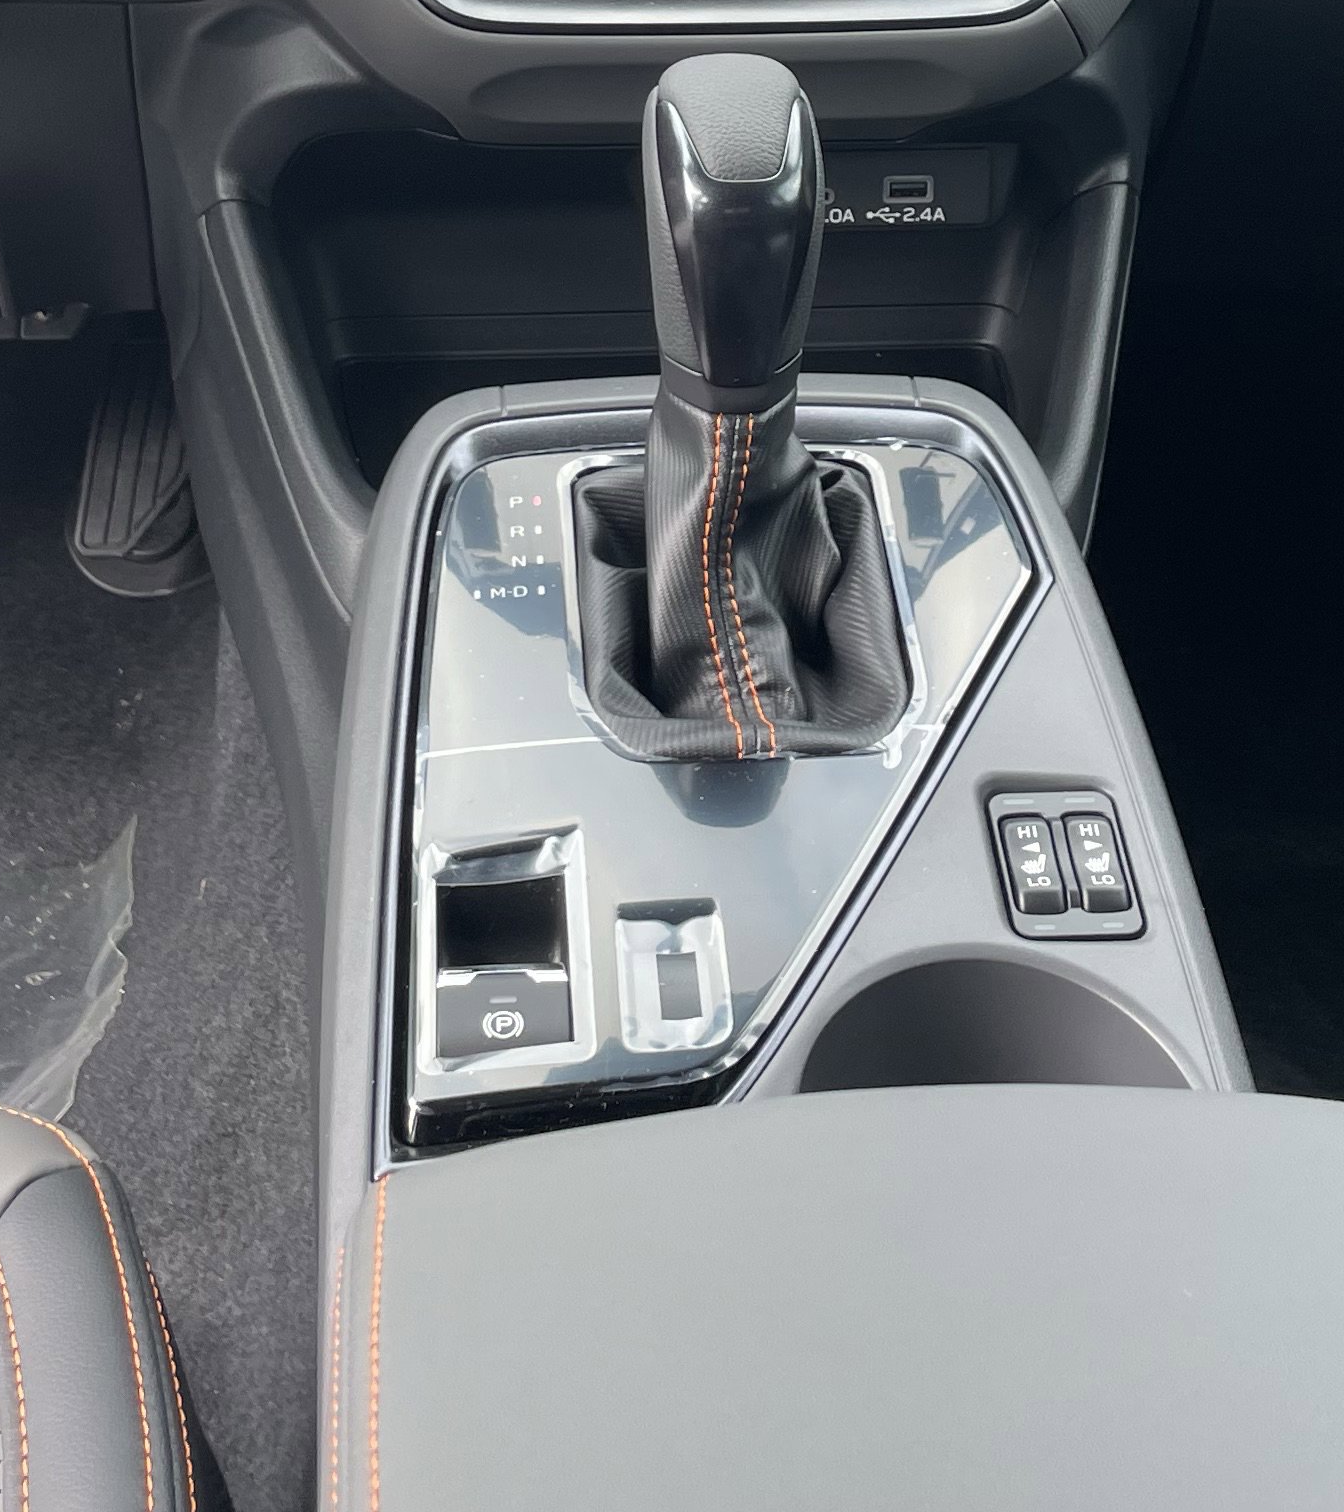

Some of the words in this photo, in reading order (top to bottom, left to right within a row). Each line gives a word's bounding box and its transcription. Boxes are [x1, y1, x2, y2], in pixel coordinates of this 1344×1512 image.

[903, 207, 945, 222] 2.4A
[510, 496, 523, 508] P
[510, 526, 525, 538] R
[511, 555, 526, 567] N
[1016, 825, 1037, 839] HI
[1079, 824, 1100, 836] HI
[1026, 876, 1051, 887] LO
[1090, 874, 1115, 886] LO
